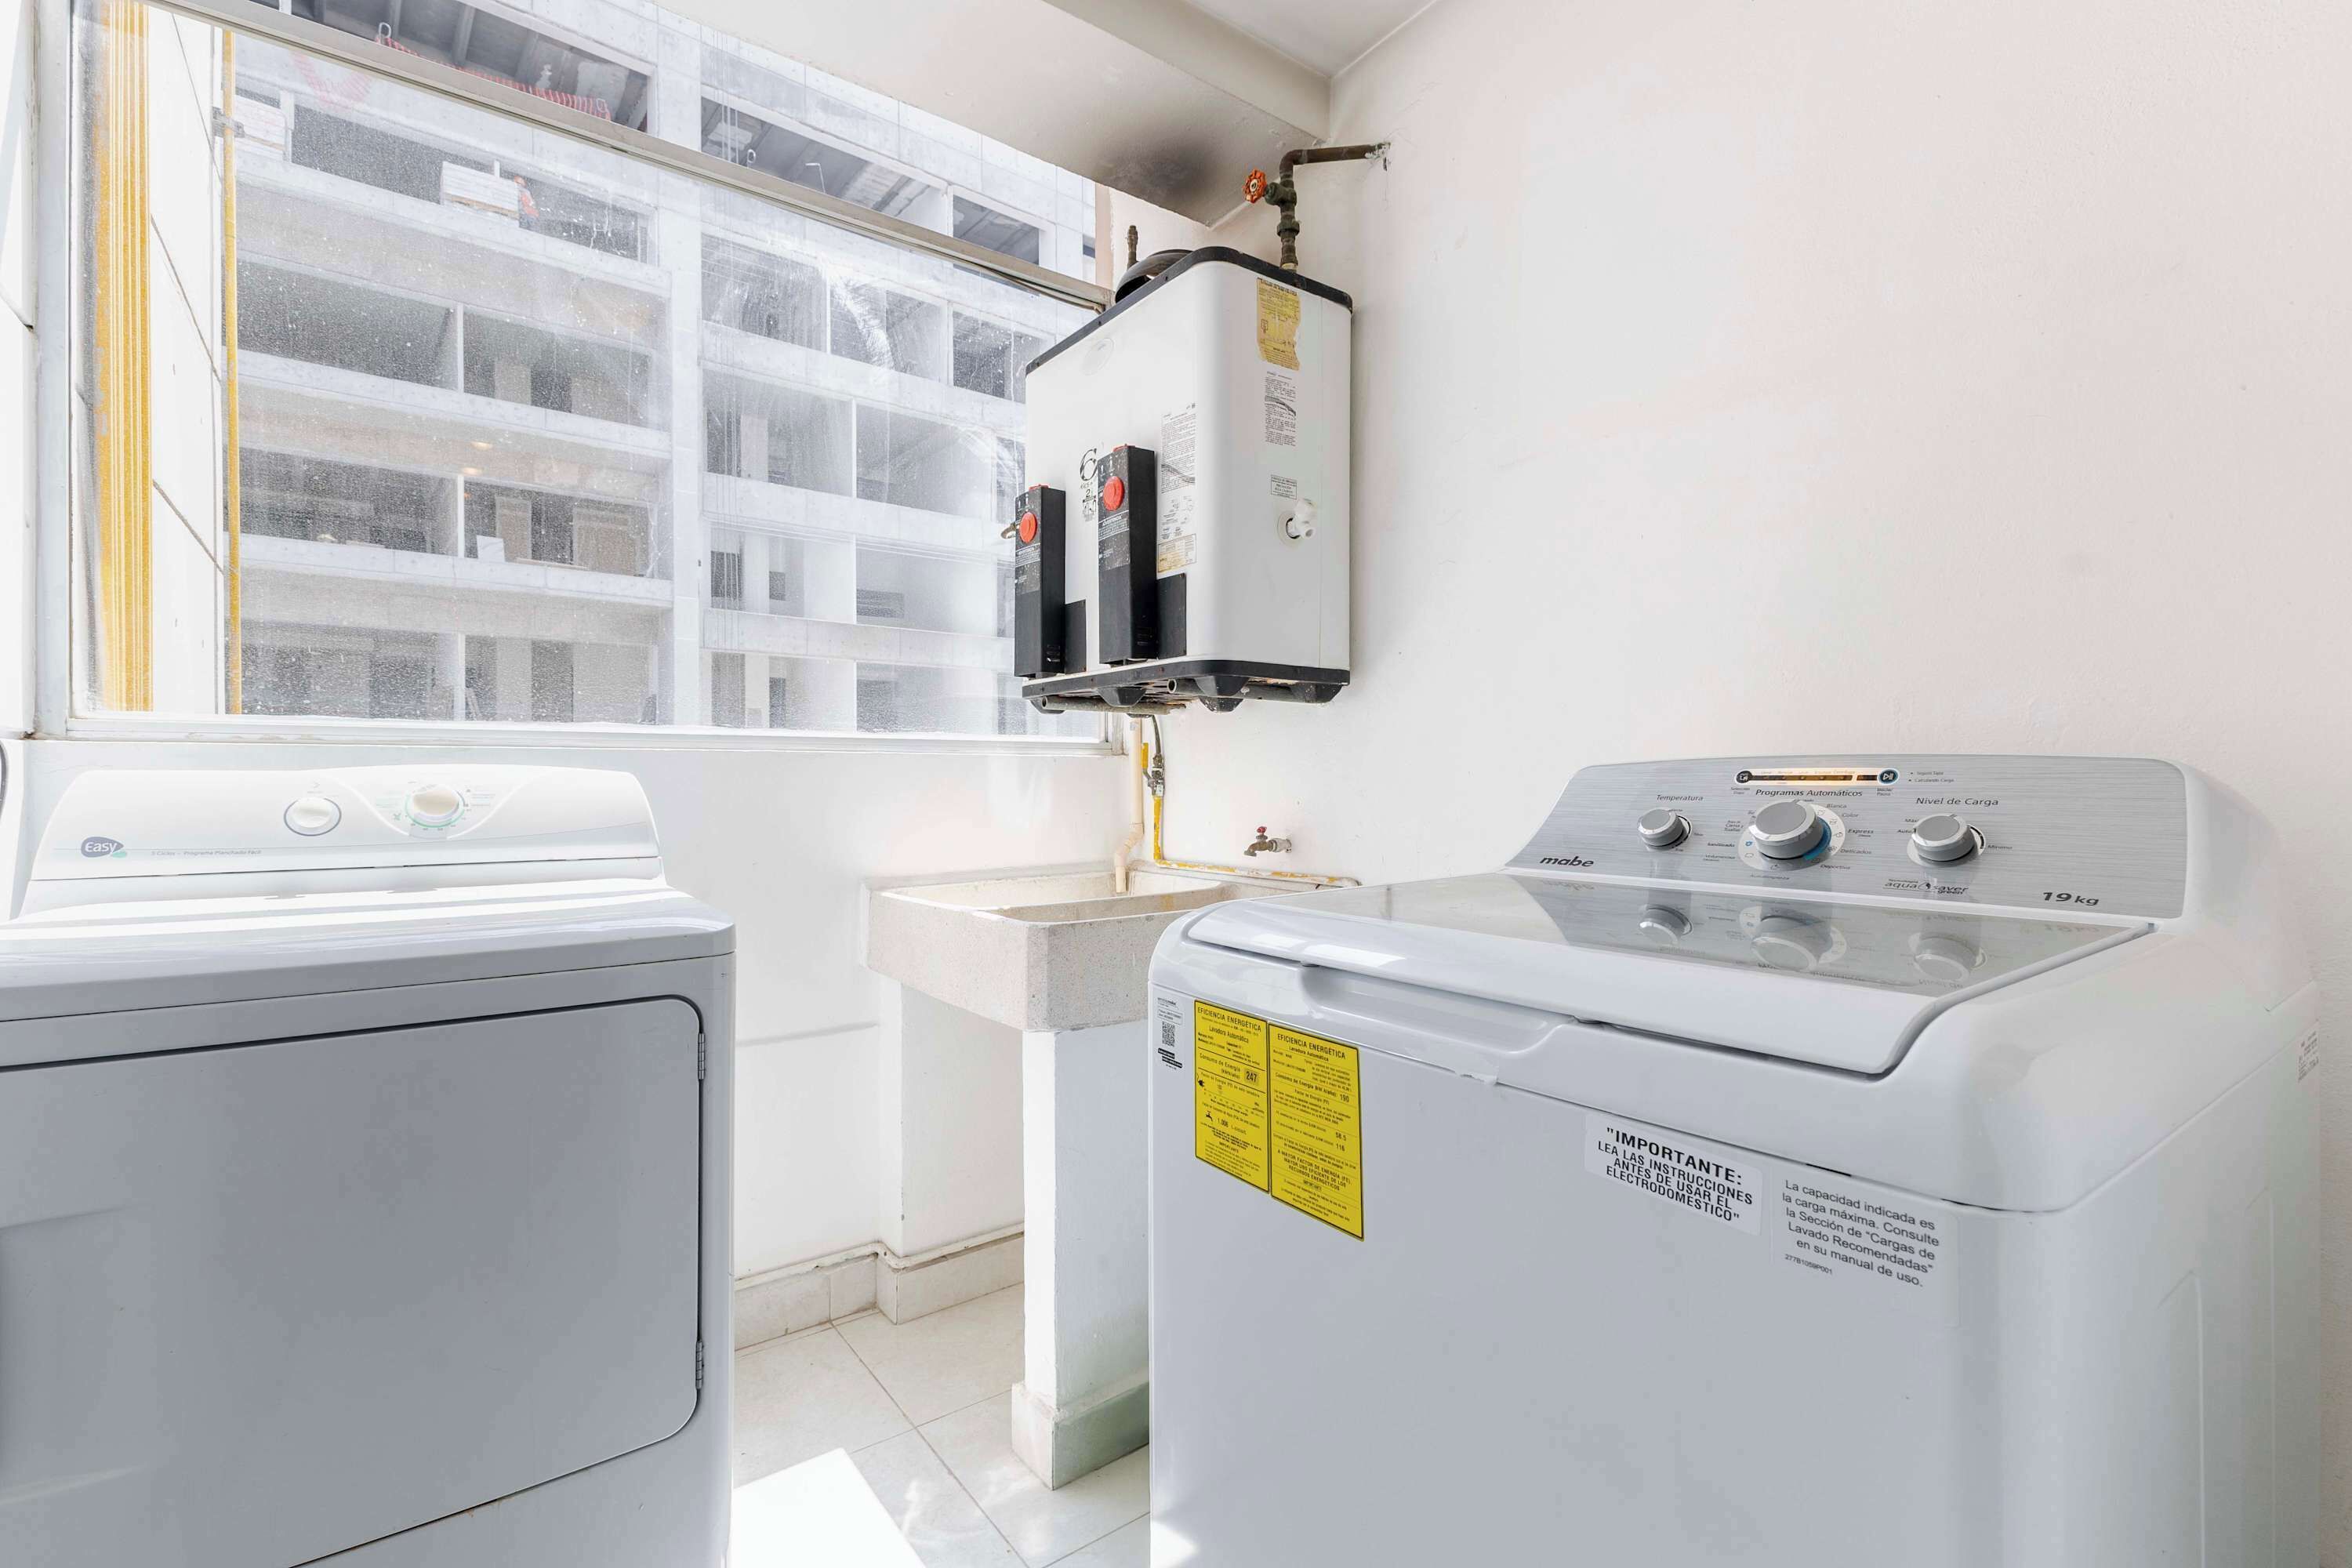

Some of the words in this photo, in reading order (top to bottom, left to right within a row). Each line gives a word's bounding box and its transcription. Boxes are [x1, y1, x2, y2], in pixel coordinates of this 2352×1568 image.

[85, 841, 118, 854] Easy
[1539, 856, 1595, 867] mabe
[1885, 881, 1917, 890] aqua
[2042, 892, 2072, 902] 19
[2074, 895, 2100, 906] kg
[1197, 1007, 1225, 1020] EFICIENCIA
[1227, 1016, 1261, 1033] ENERGÉTICA
[1277, 1033, 1307, 1047] EFICIENCIA
[1308, 1042, 1345, 1058] ENERGÉTICA
[1246, 1071, 1258, 1082] 247
[1281, 1150, 1296, 1159] MAYOR
[1297, 1157, 1313, 1167] FACTOR
[1606, 1127, 1742, 1185] "IMPORTANTE:
[1284, 1157, 1298, 1166] MAYOR
[1308, 1168, 1330, 1181] EFICIENTE
[1288, 1164, 1310, 1178] RECURSOS
[1598, 1141, 1618, 1156] LEA
[1623, 1149, 1644, 1166] LAS
[1650, 1159, 1753, 1205] INSTRUCCIONES
[1606, 1165, 1740, 1221] ELECTRODOMESTICO"
[1613, 1158, 1651, 1179] ANTES
[1657, 1174, 1671, 1187] DE
[1676, 1180, 1711, 1202] USAR
[1716, 1195, 1732, 1210] EL
[1786, 1179, 1799, 1192] La
[1802, 1184, 1861, 1210] capacidad
[1864, 1201, 1915, 1225] indicada
[1919, 1218, 1936, 1230] es
[1782, 1192, 1792, 1203] la
[1795, 1196, 1827, 1214] carga
[1830, 1207, 1879, 1229] máxima.
[1883, 1221, 1940, 1247] Consulte
[1788, 1221, 1829, 1243] Lavado
[1786, 1207, 1796, 1218] la
[1799, 1211, 1844, 1233] Sección
[1847, 1225, 1863, 1239] de
[1918, 1247, 1936, 1261] de
[1796, 1239, 1810, 1250] en
[1813, 1244, 1828, 1256] su
[1831, 1249, 1874, 1271] manual
[1877, 1263, 1893, 1277] de
[1896, 1272, 1923, 1287] uso.
